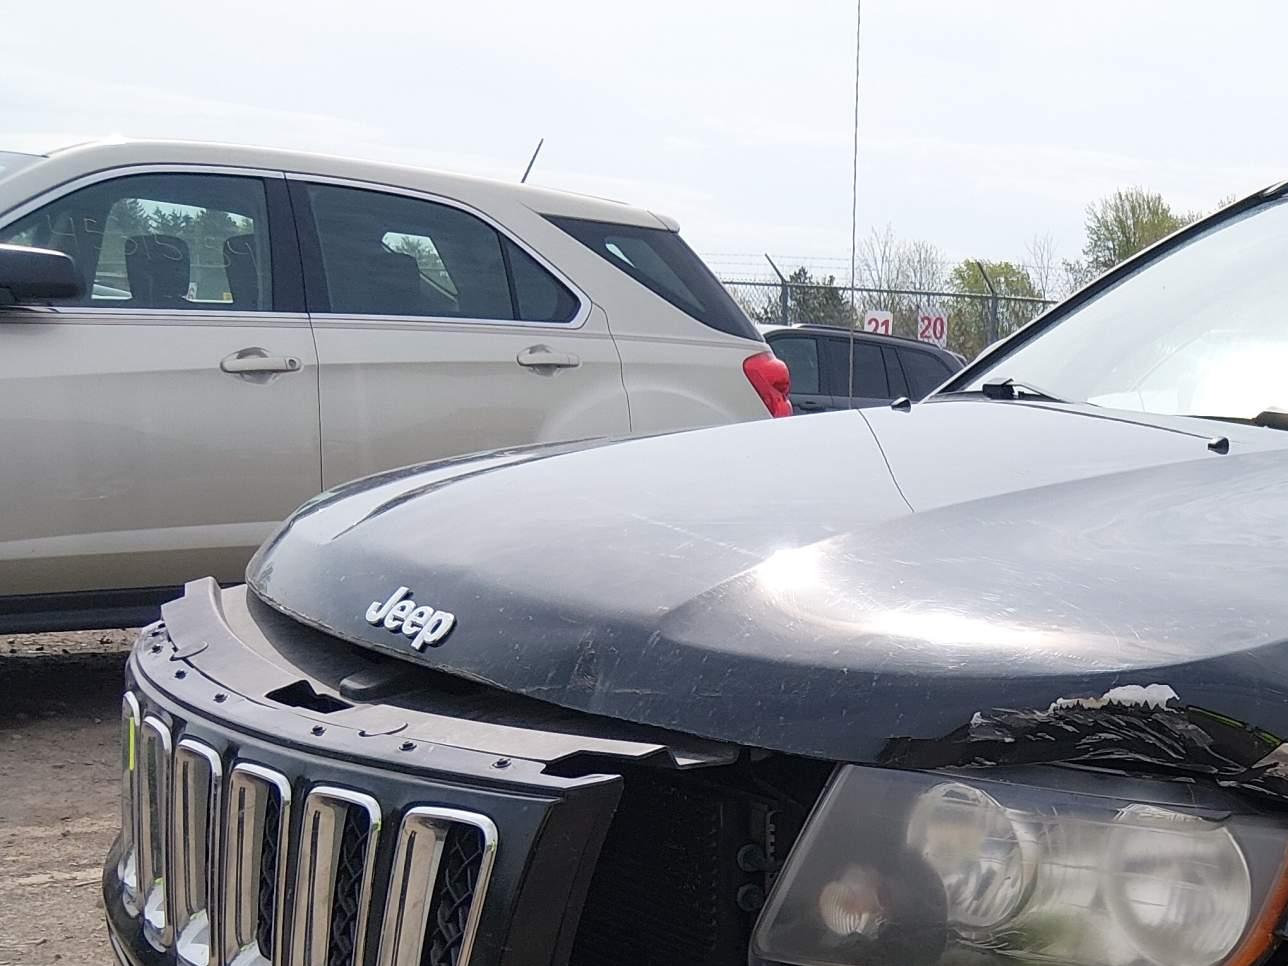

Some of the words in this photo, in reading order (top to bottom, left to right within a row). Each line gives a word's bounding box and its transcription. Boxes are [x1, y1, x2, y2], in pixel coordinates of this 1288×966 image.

[867, 318, 890, 336] 21
[919, 316, 945, 340] 20
[365, 586, 456, 652] Jeep
